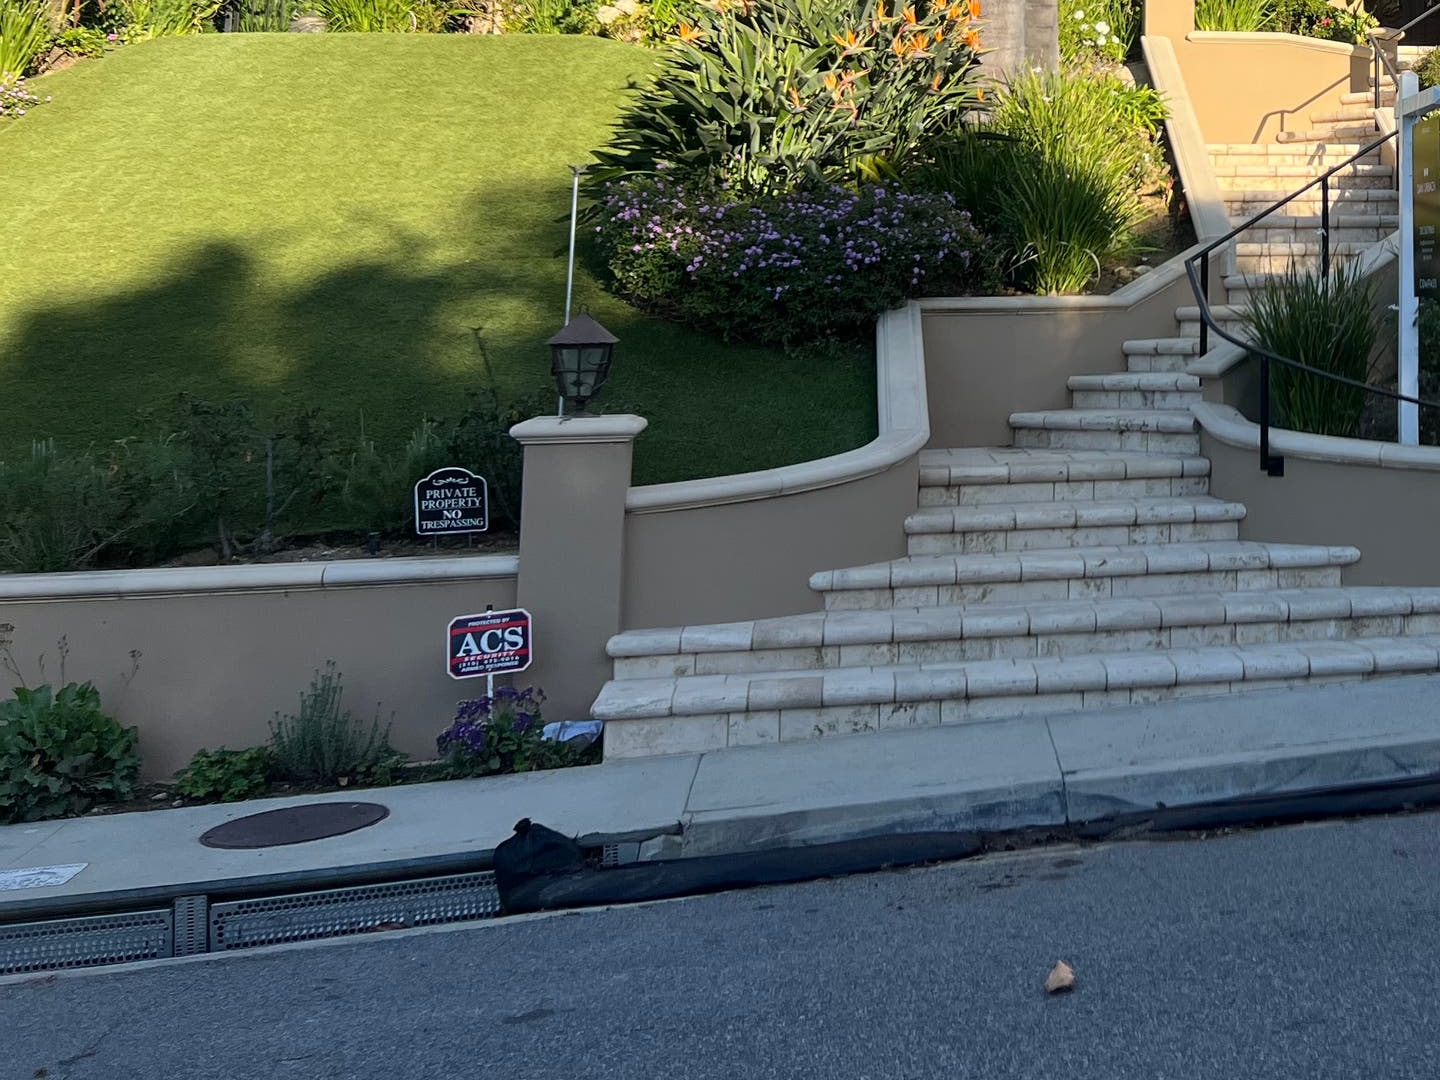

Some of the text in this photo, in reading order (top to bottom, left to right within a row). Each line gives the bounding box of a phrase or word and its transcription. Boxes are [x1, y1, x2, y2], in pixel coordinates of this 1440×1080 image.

[426, 487, 477, 499] PRIVATE
[421, 497, 482, 510] PROPERTY
[442, 509, 462, 520] NO
[420, 517, 484, 530] TRESPASSING
[468, 618, 501, 627] PROTECTED
[456, 626, 524, 657] ACS
[464, 651, 515, 662] SECURITY
